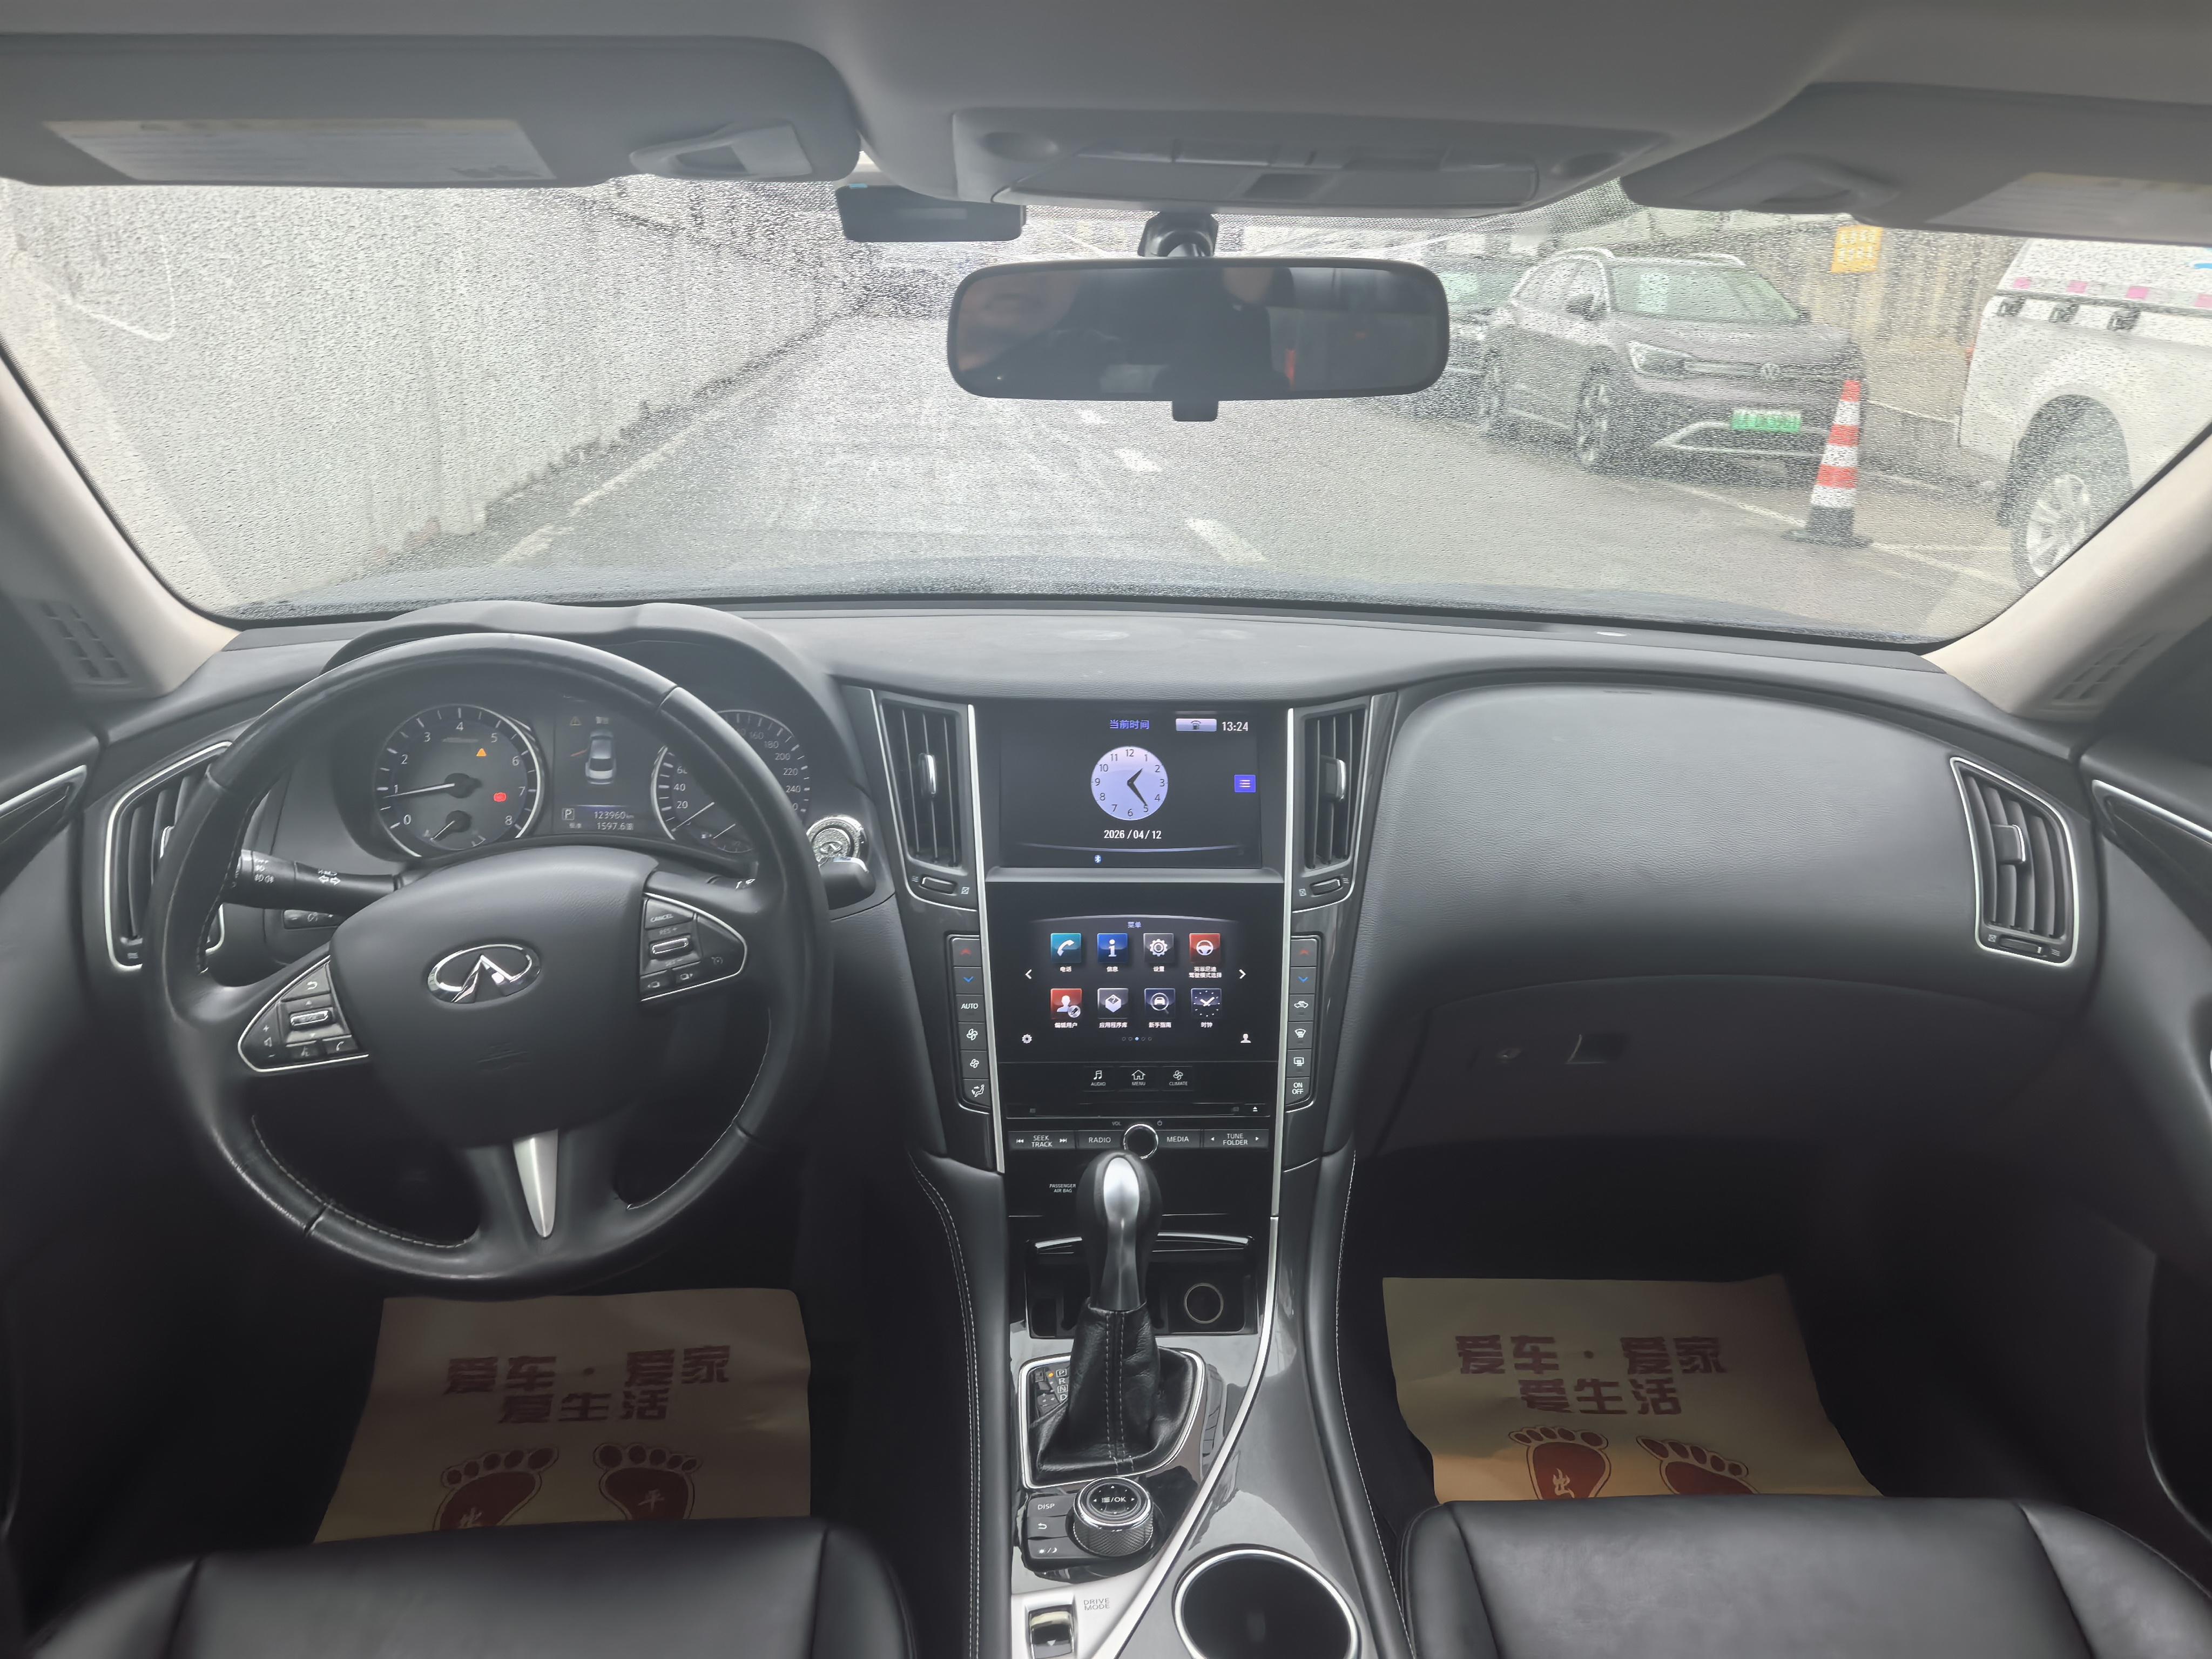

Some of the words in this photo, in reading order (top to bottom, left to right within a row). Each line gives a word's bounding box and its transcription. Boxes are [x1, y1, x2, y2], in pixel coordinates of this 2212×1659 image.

[456, 722, 463, 731] 4
[1109, 719, 1150, 730] 当前时间
[1222, 721, 1249, 732] 13:24
[423, 732, 430, 742] 3
[491, 733, 497, 743] 5
[1125, 749, 1134, 757] 12
[401, 754, 408, 764] 2
[512, 756, 520, 766] 6
[1099, 764, 1108, 772] 10
[1155, 765, 1161, 773] 2
[1095, 778, 1100, 786] 9
[1159, 779, 1165, 787] 3
[394, 784, 398, 793] 1
[519, 786, 525, 797] 7
[1100, 793, 1105, 801] 8
[1155, 794, 1161, 802] 4
[1111, 804, 1117, 812] 7
[1143, 805, 1149, 813] 5
[403, 814, 412, 825] 0
[505, 815, 512, 825] 8
[1519, 1378, 1682, 1415] 爱生活
